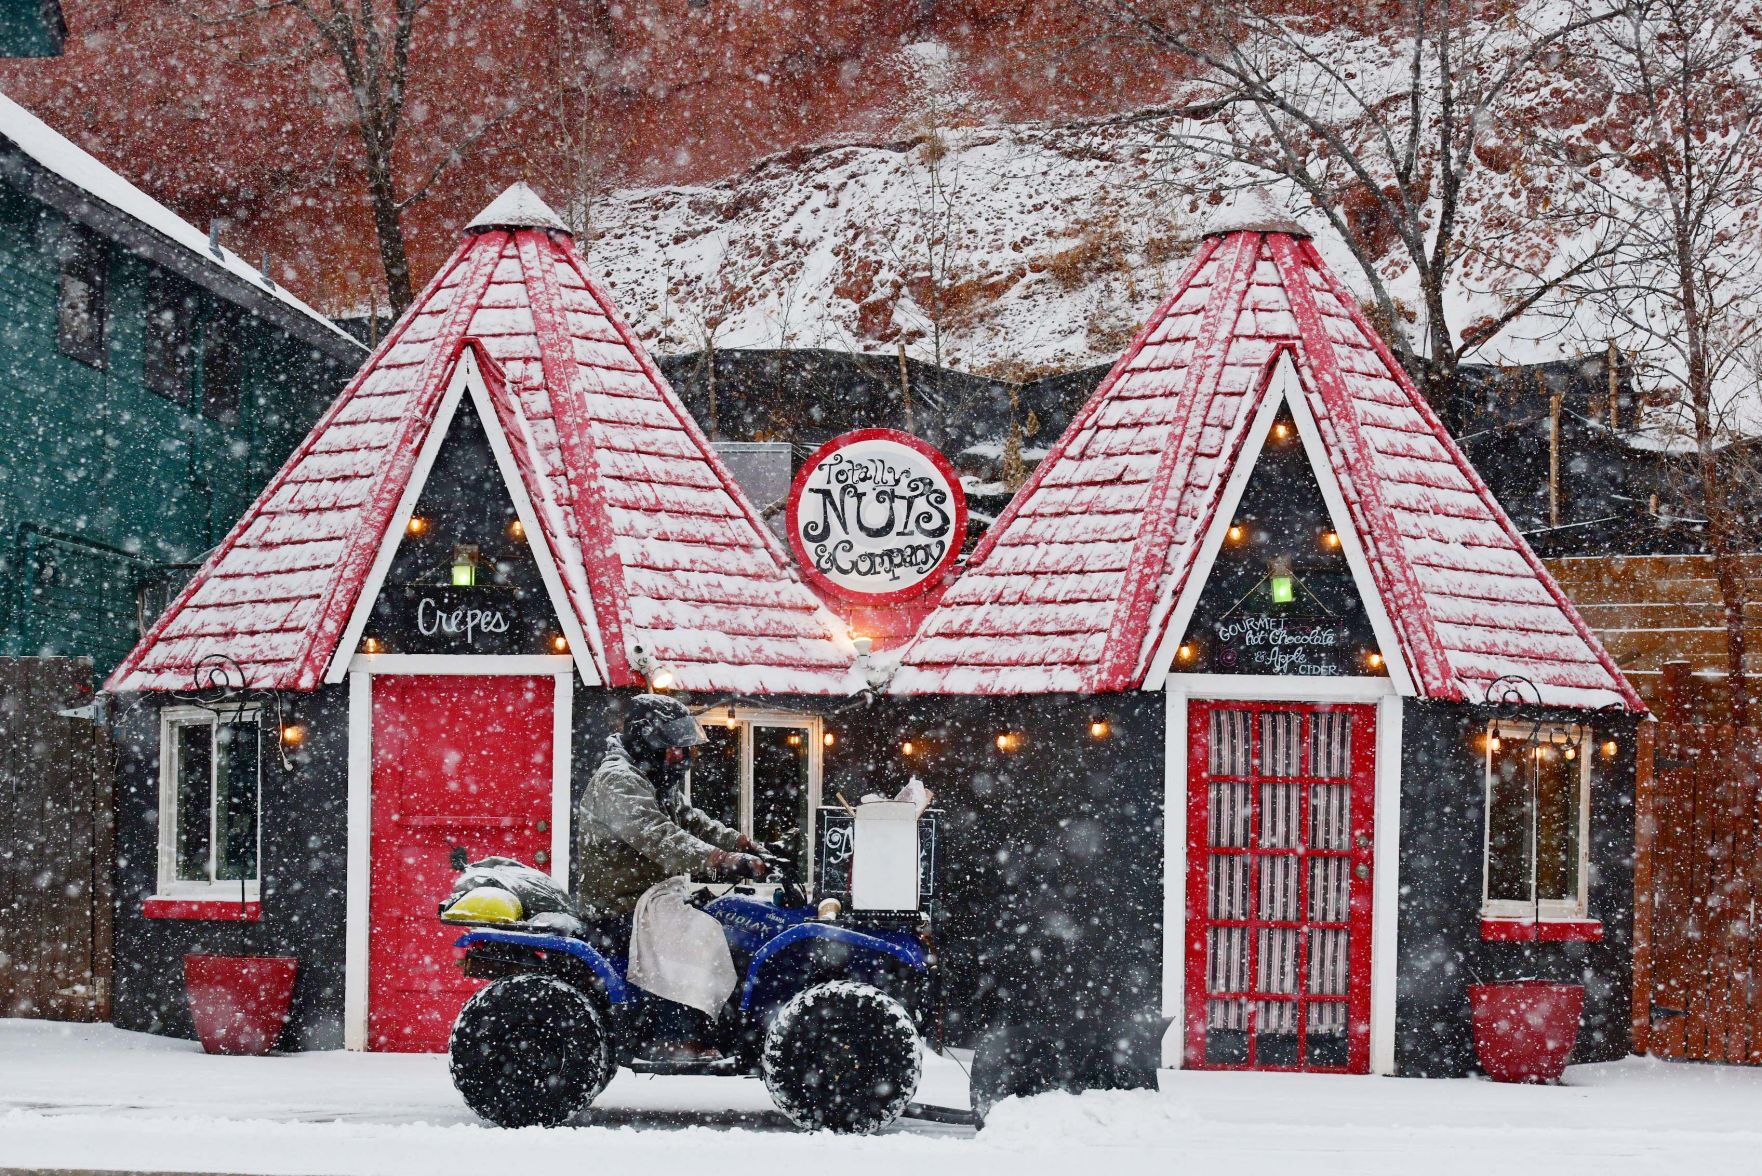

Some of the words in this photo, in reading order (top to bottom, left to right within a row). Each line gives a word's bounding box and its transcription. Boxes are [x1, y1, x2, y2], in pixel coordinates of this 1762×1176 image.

[818, 453, 911, 490] Totally
[803, 476, 950, 543] NUTS
[1219, 617, 1285, 642] GOURMET
[1269, 628, 1336, 645] Chocolate
[1265, 646, 1307, 673] Apple
[1299, 664, 1337, 675] CIDER
[715, 909, 773, 934] KODIAK
